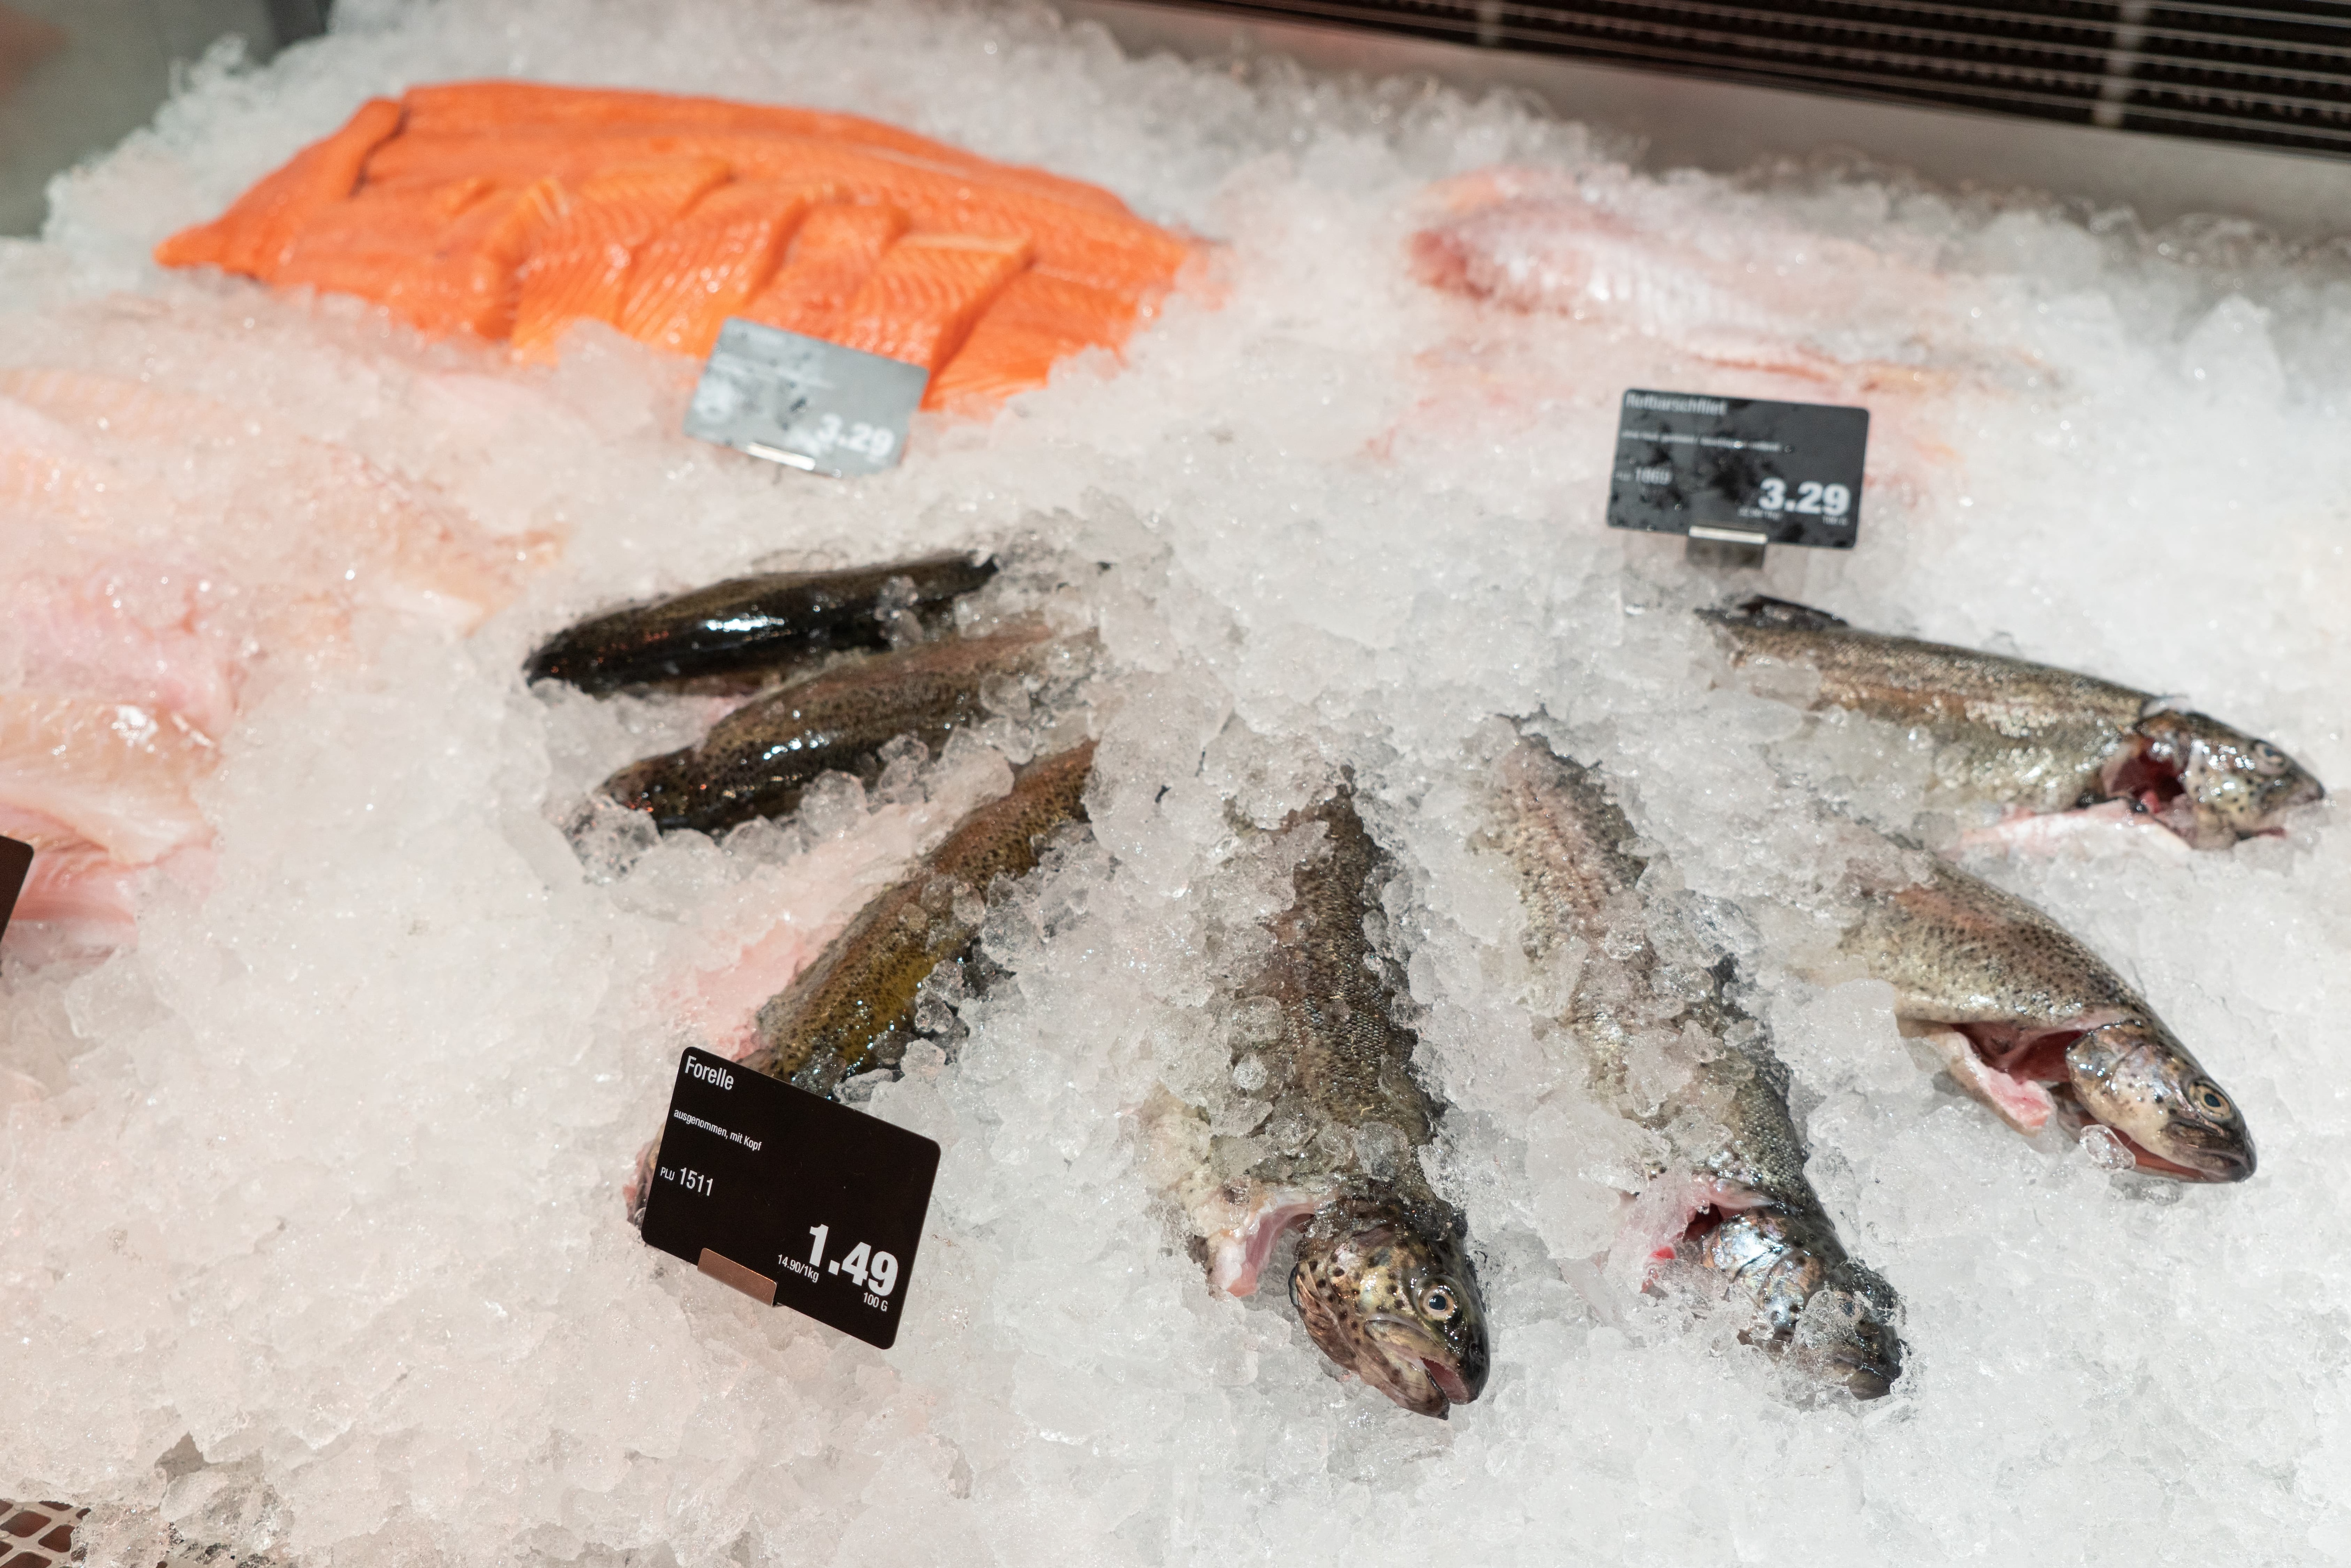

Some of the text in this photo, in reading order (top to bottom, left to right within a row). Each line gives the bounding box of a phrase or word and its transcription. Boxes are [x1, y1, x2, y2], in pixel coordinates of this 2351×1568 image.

[816, 413, 894, 457] 3.29
[1759, 478, 1851, 516] 3.29
[685, 1056, 734, 1090] Forelle
[674, 1110, 762, 1151] ausgenommen, mit Kopf
[660, 1167, 713, 1196] PLU 1511
[778, 1254, 819, 1283] 14.90/1kg
[809, 1224, 898, 1296] 1.49
[863, 1292, 888, 1312] 100 G
